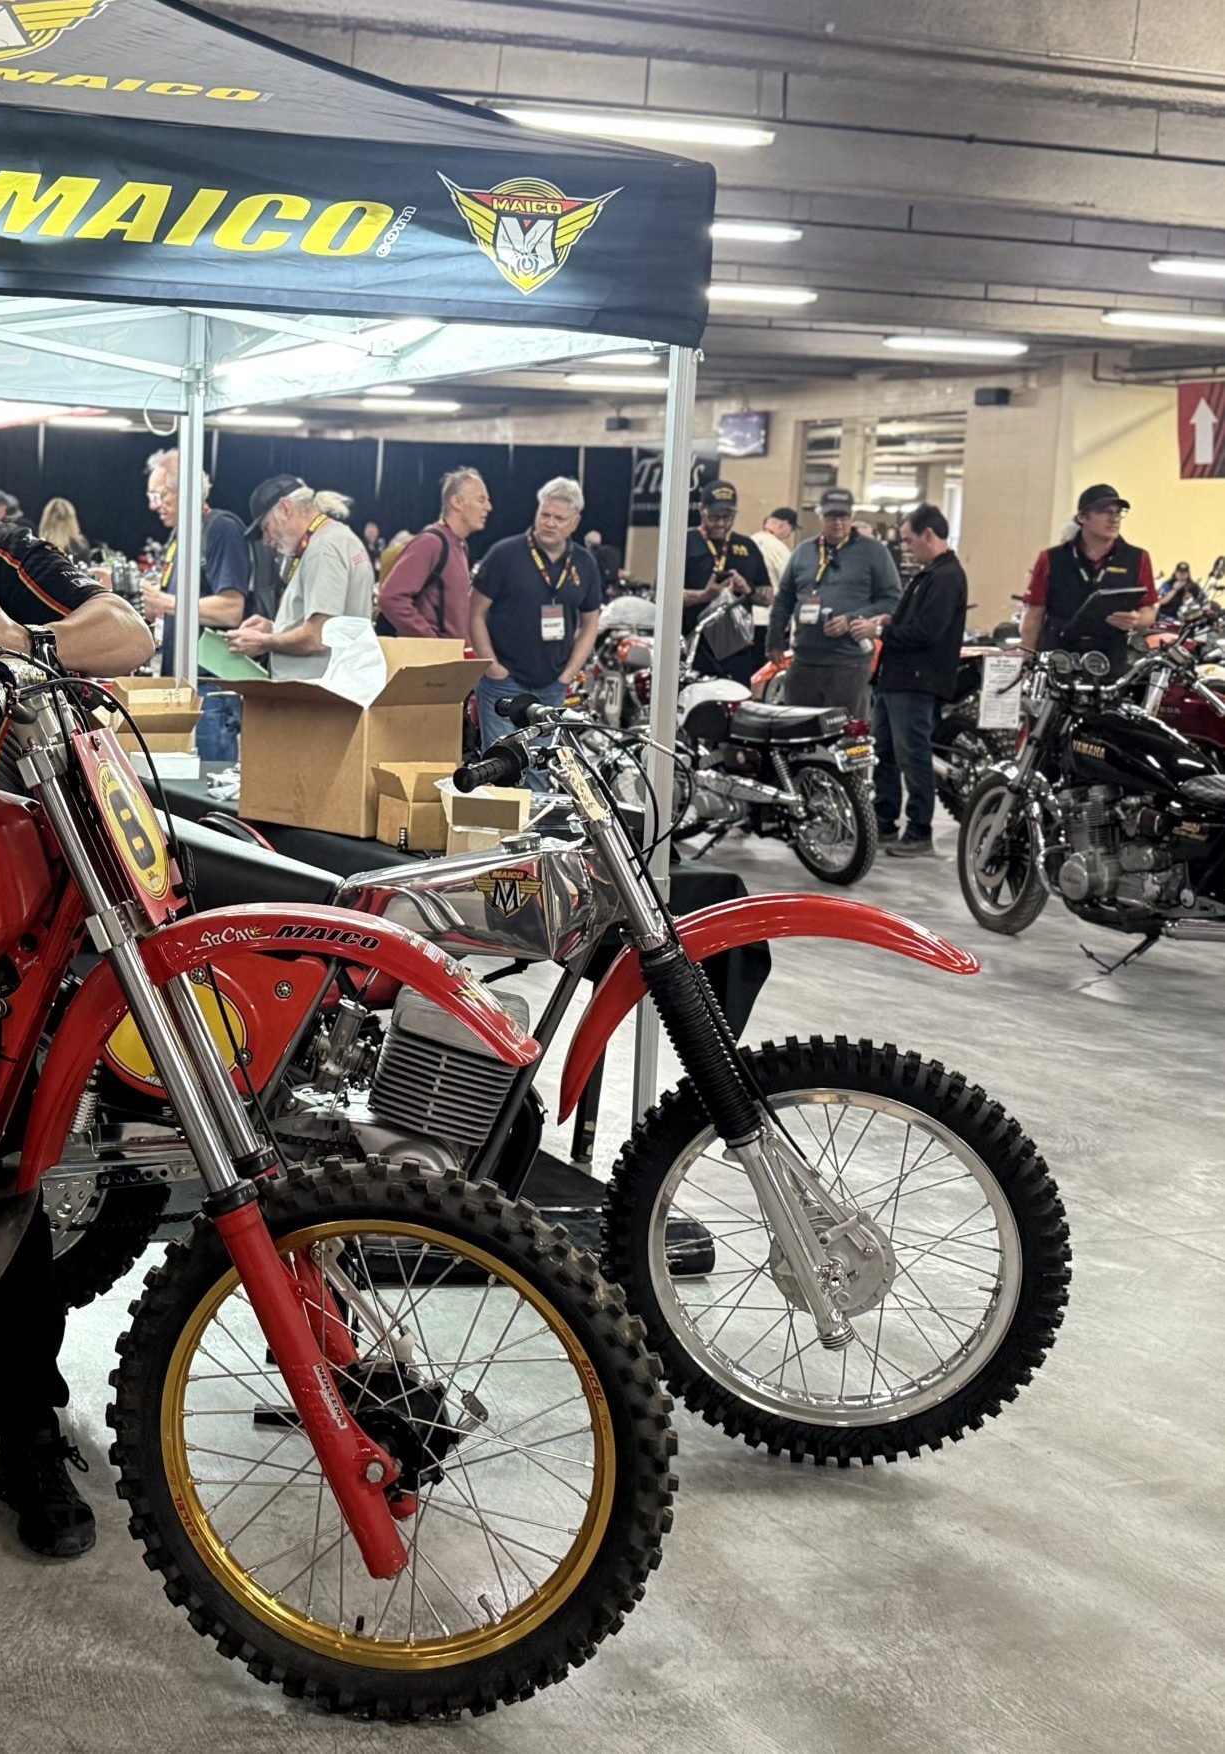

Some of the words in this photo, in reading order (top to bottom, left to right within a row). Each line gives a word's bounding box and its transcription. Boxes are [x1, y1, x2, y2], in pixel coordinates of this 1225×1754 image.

[492, 197, 564, 215] MAICO
[1072, 739, 1106, 759] YAMAHA
[109, 789, 156, 871] 8
[491, 870, 525, 879] MAICO
[275, 924, 381, 950] MAICO
[316, 1365, 343, 1417] NOLEEN
[581, 1360, 603, 1404] EXCEL
[175, 1494, 199, 1536] EXCEL
